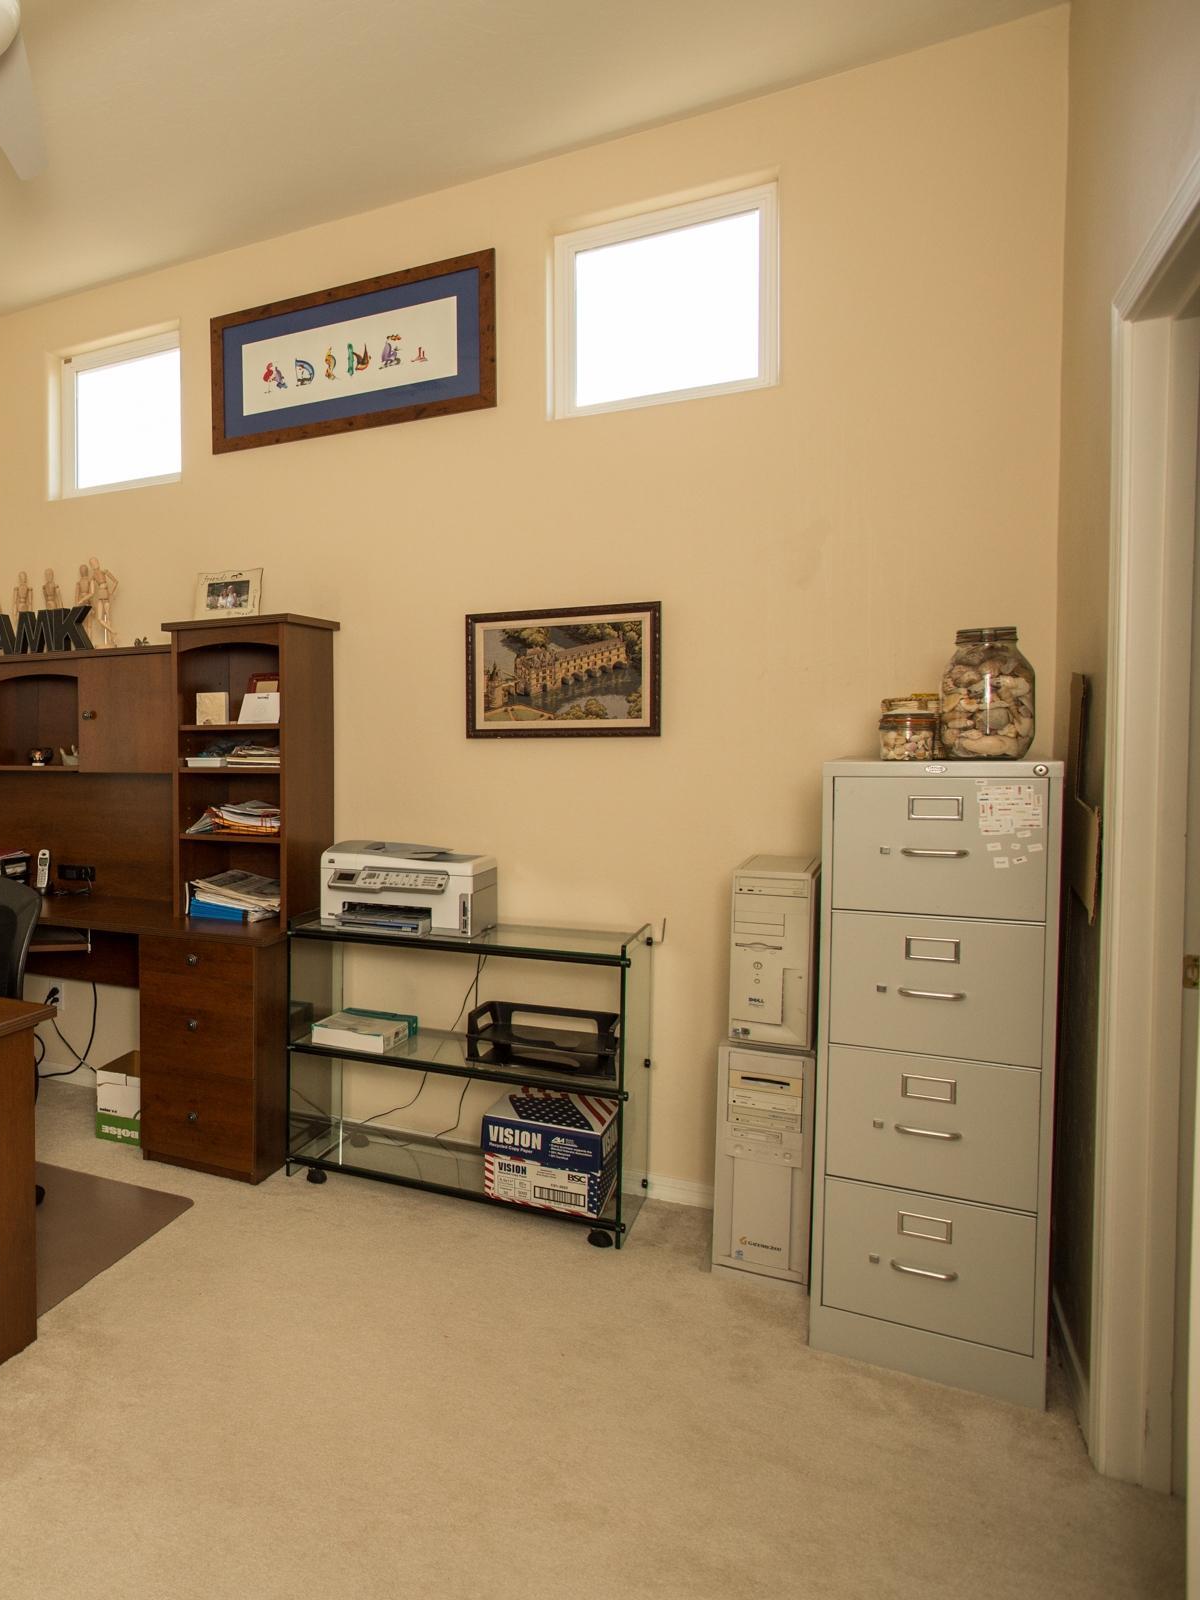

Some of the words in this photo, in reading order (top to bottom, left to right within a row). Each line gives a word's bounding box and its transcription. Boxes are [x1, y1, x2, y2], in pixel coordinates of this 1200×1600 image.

[488, 1124, 542, 1150] VISION
[498, 1161, 527, 1175] VISION
[567, 1173, 586, 1184] BSC
